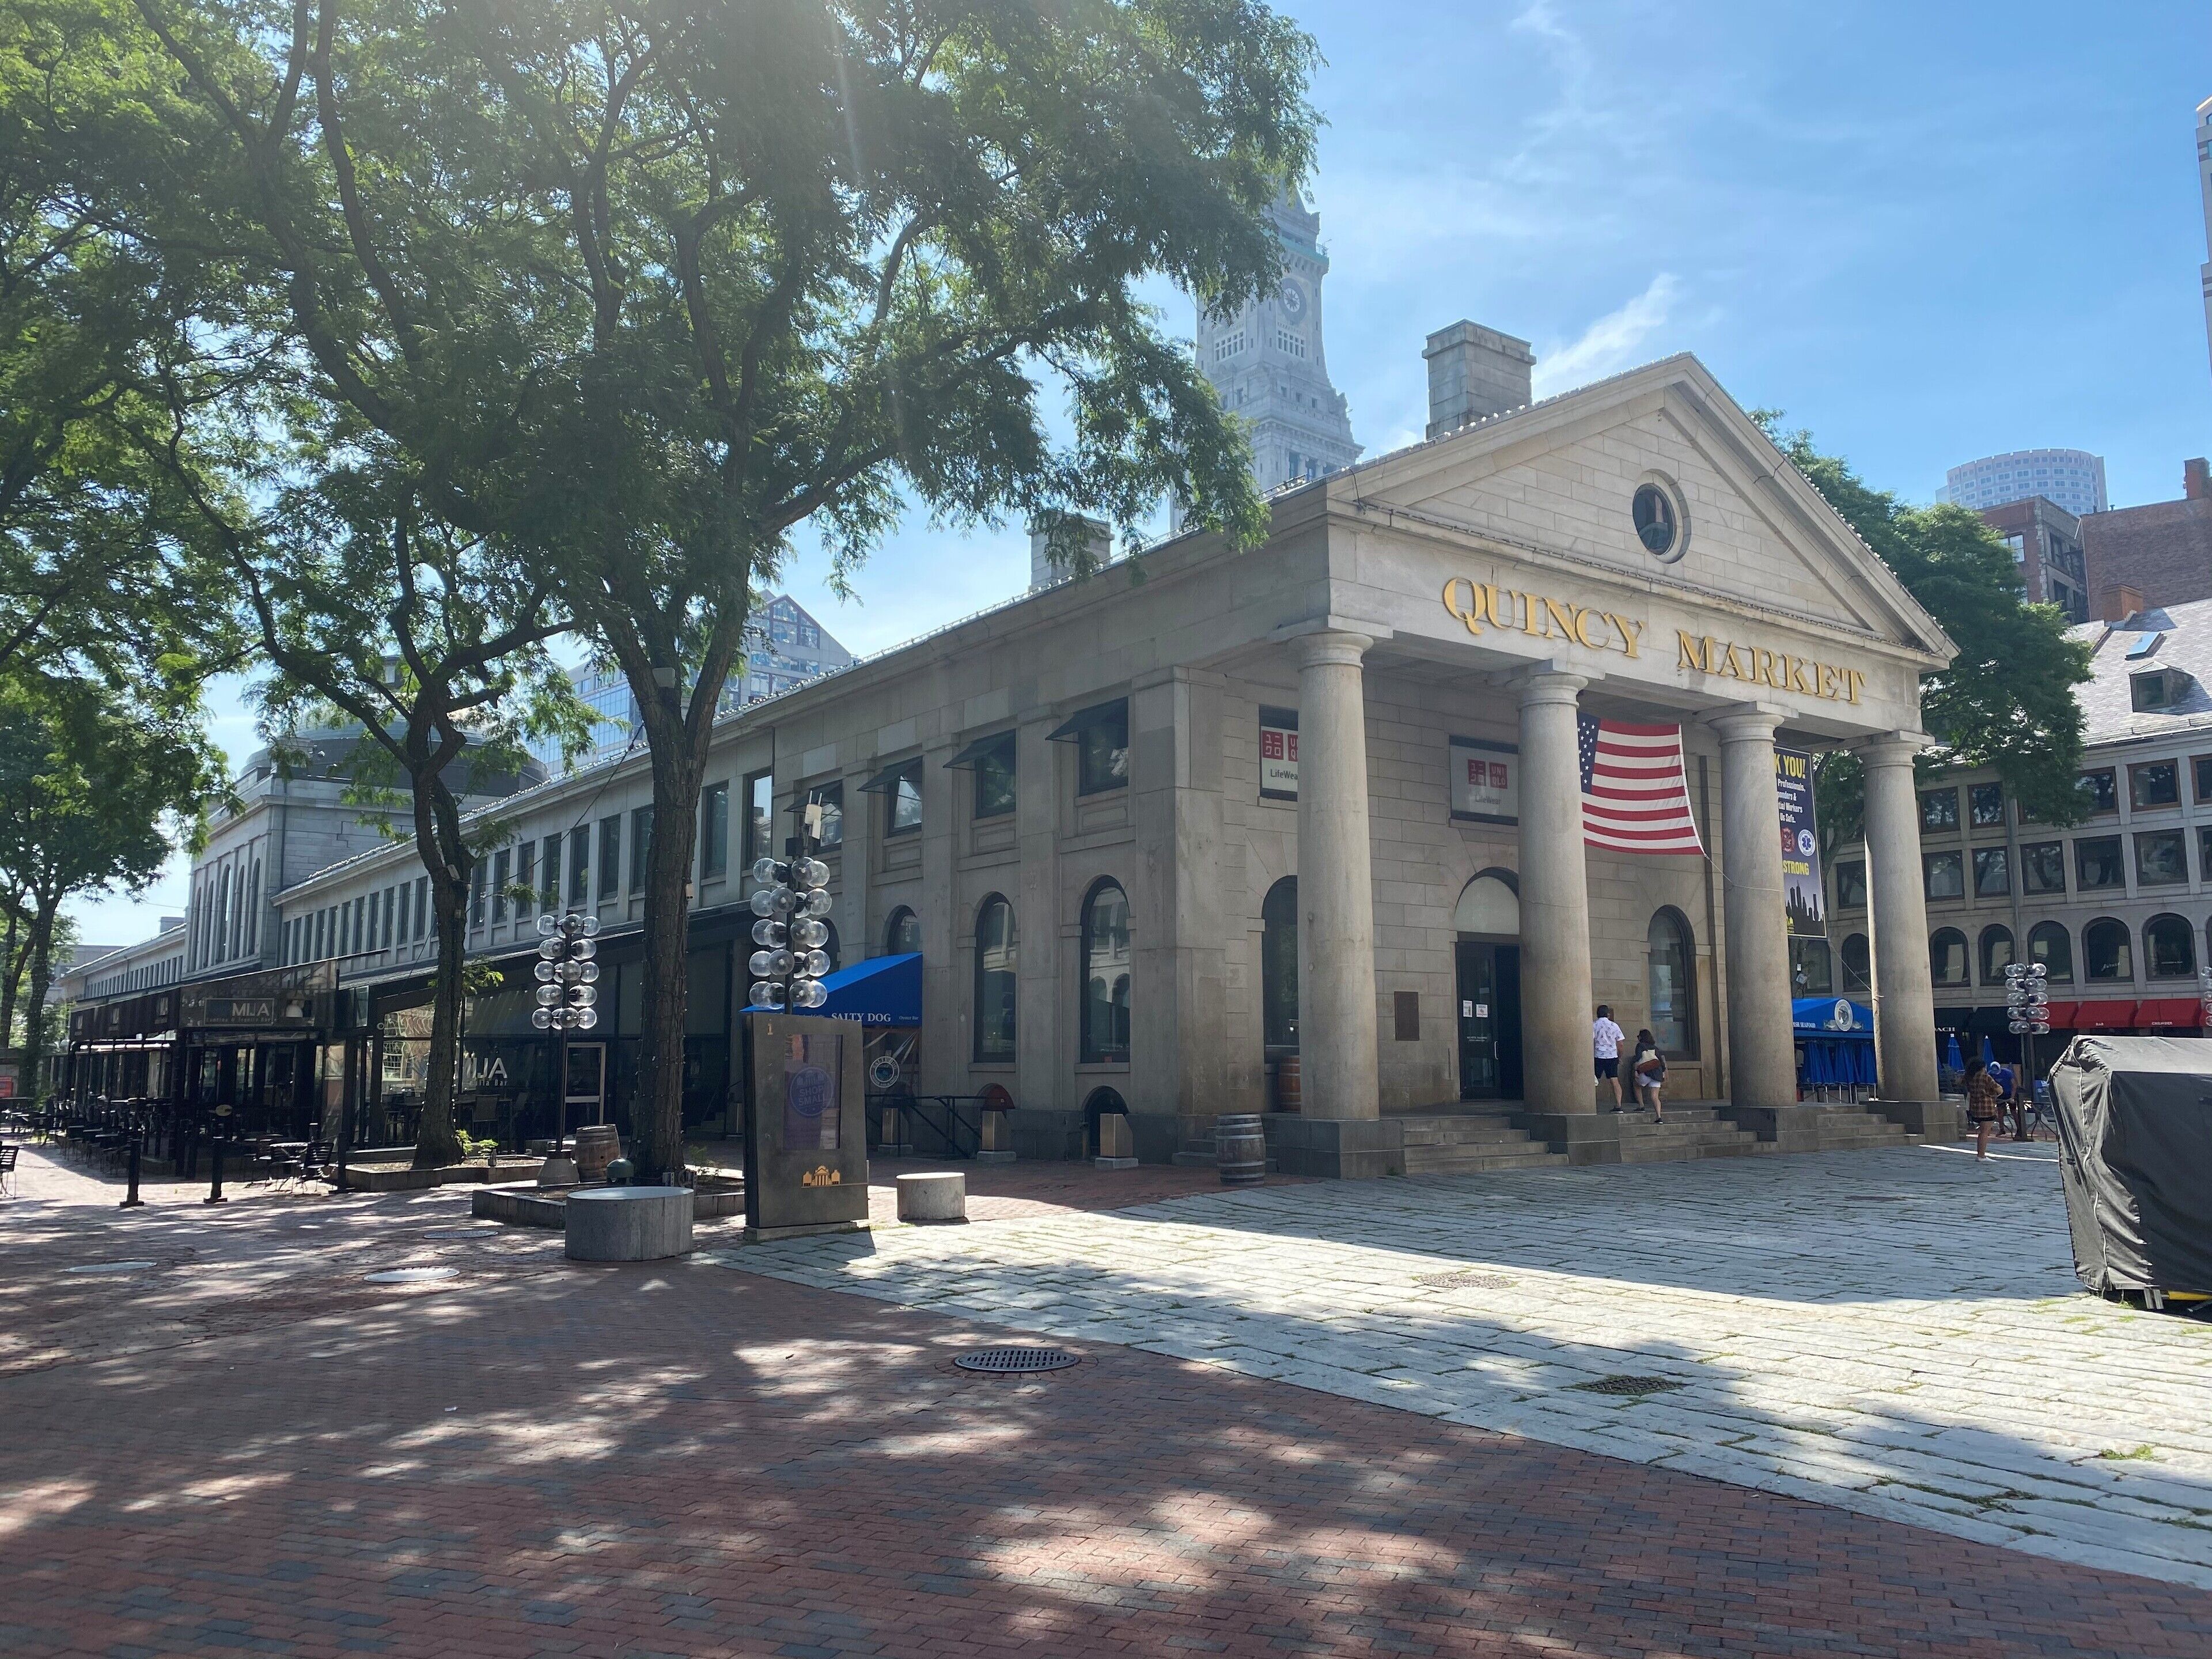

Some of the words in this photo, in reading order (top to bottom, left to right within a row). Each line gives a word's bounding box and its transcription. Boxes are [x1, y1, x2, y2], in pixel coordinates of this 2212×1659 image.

[1443, 577, 1645, 658] QUINCY
[1677, 629, 1866, 704] MARKET
[1783, 755, 1806, 779] YOU!
[1270, 768, 1298, 779] LifeWea
[1793, 793, 1797, 801] &
[1786, 801, 1803, 813] Workers
[1780, 812, 1785, 821] Us
[1783, 860, 1810, 876] STRONG
[831, 1013, 865, 1022] SALTY
[868, 1013, 891, 1022] DOG
